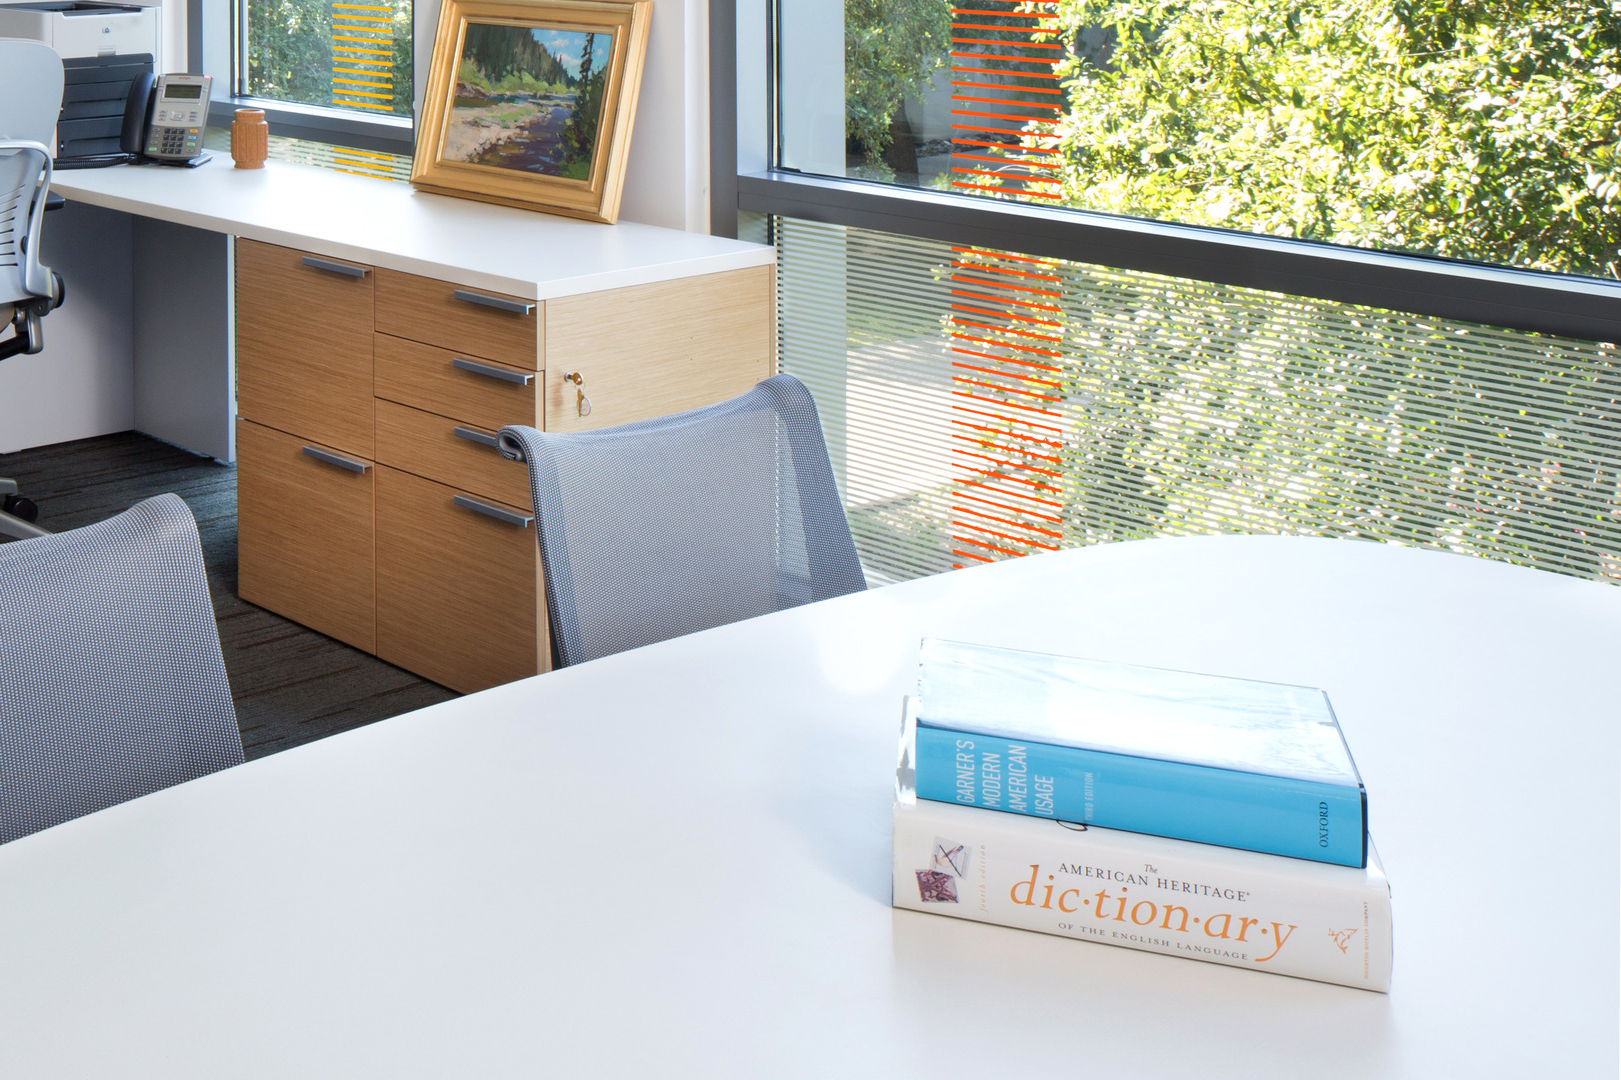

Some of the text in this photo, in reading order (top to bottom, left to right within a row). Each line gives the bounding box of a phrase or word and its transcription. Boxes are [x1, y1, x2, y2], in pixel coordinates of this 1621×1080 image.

[956, 739, 975, 804] GARNER'S
[982, 752, 1001, 808] MODERN
[1008, 744, 1027, 812] AMERICAN
[1084, 772, 1094, 801] EDITION
[1035, 774, 1054, 816] USAGE
[1319, 801, 1328, 848] OXFORD
[1058, 863, 1149, 886] AMERICAN
[1144, 864, 1158, 874] The
[1058, 922, 1248, 960] OF THE ENGLISH LANGUAGE
